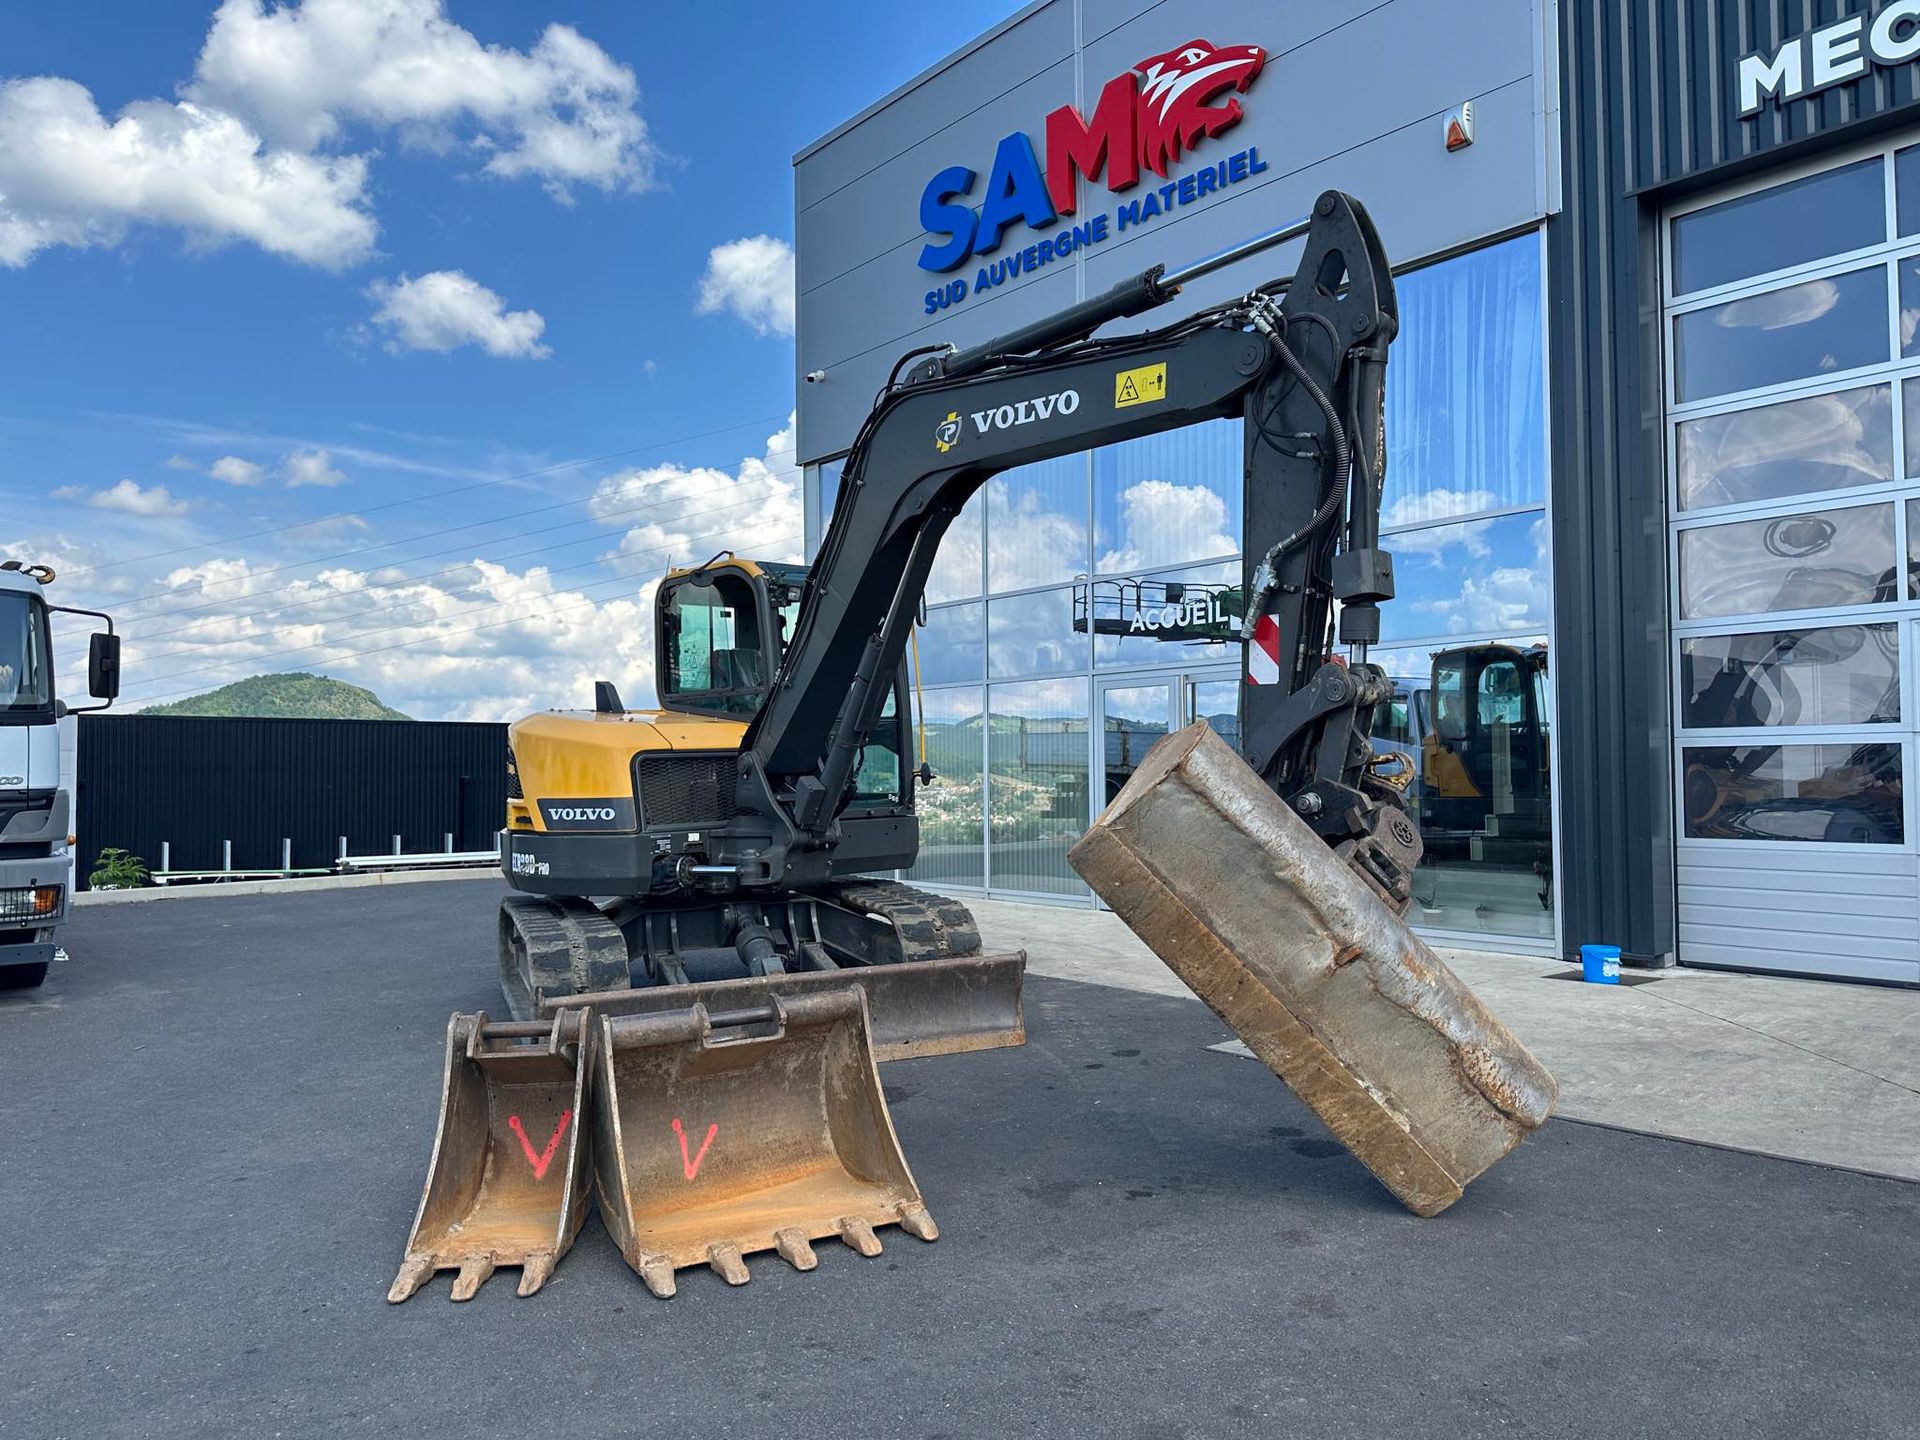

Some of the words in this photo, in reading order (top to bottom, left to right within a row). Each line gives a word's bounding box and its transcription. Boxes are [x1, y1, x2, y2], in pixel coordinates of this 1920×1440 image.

[1740, 0, 1920, 112] MEC
[918, 72, 1140, 273] SAM
[924, 279, 968, 315] SUD
[974, 213, 1109, 295] AUVERGNE
[1118, 146, 1269, 231] MATERIEL
[971, 389, 1080, 433] VOLVO
[1129, 598, 1229, 633] ACCUEIL
[548, 808, 616, 821] VOLVO
[508, 1109, 573, 1179] V
[671, 1117, 719, 1180] V
